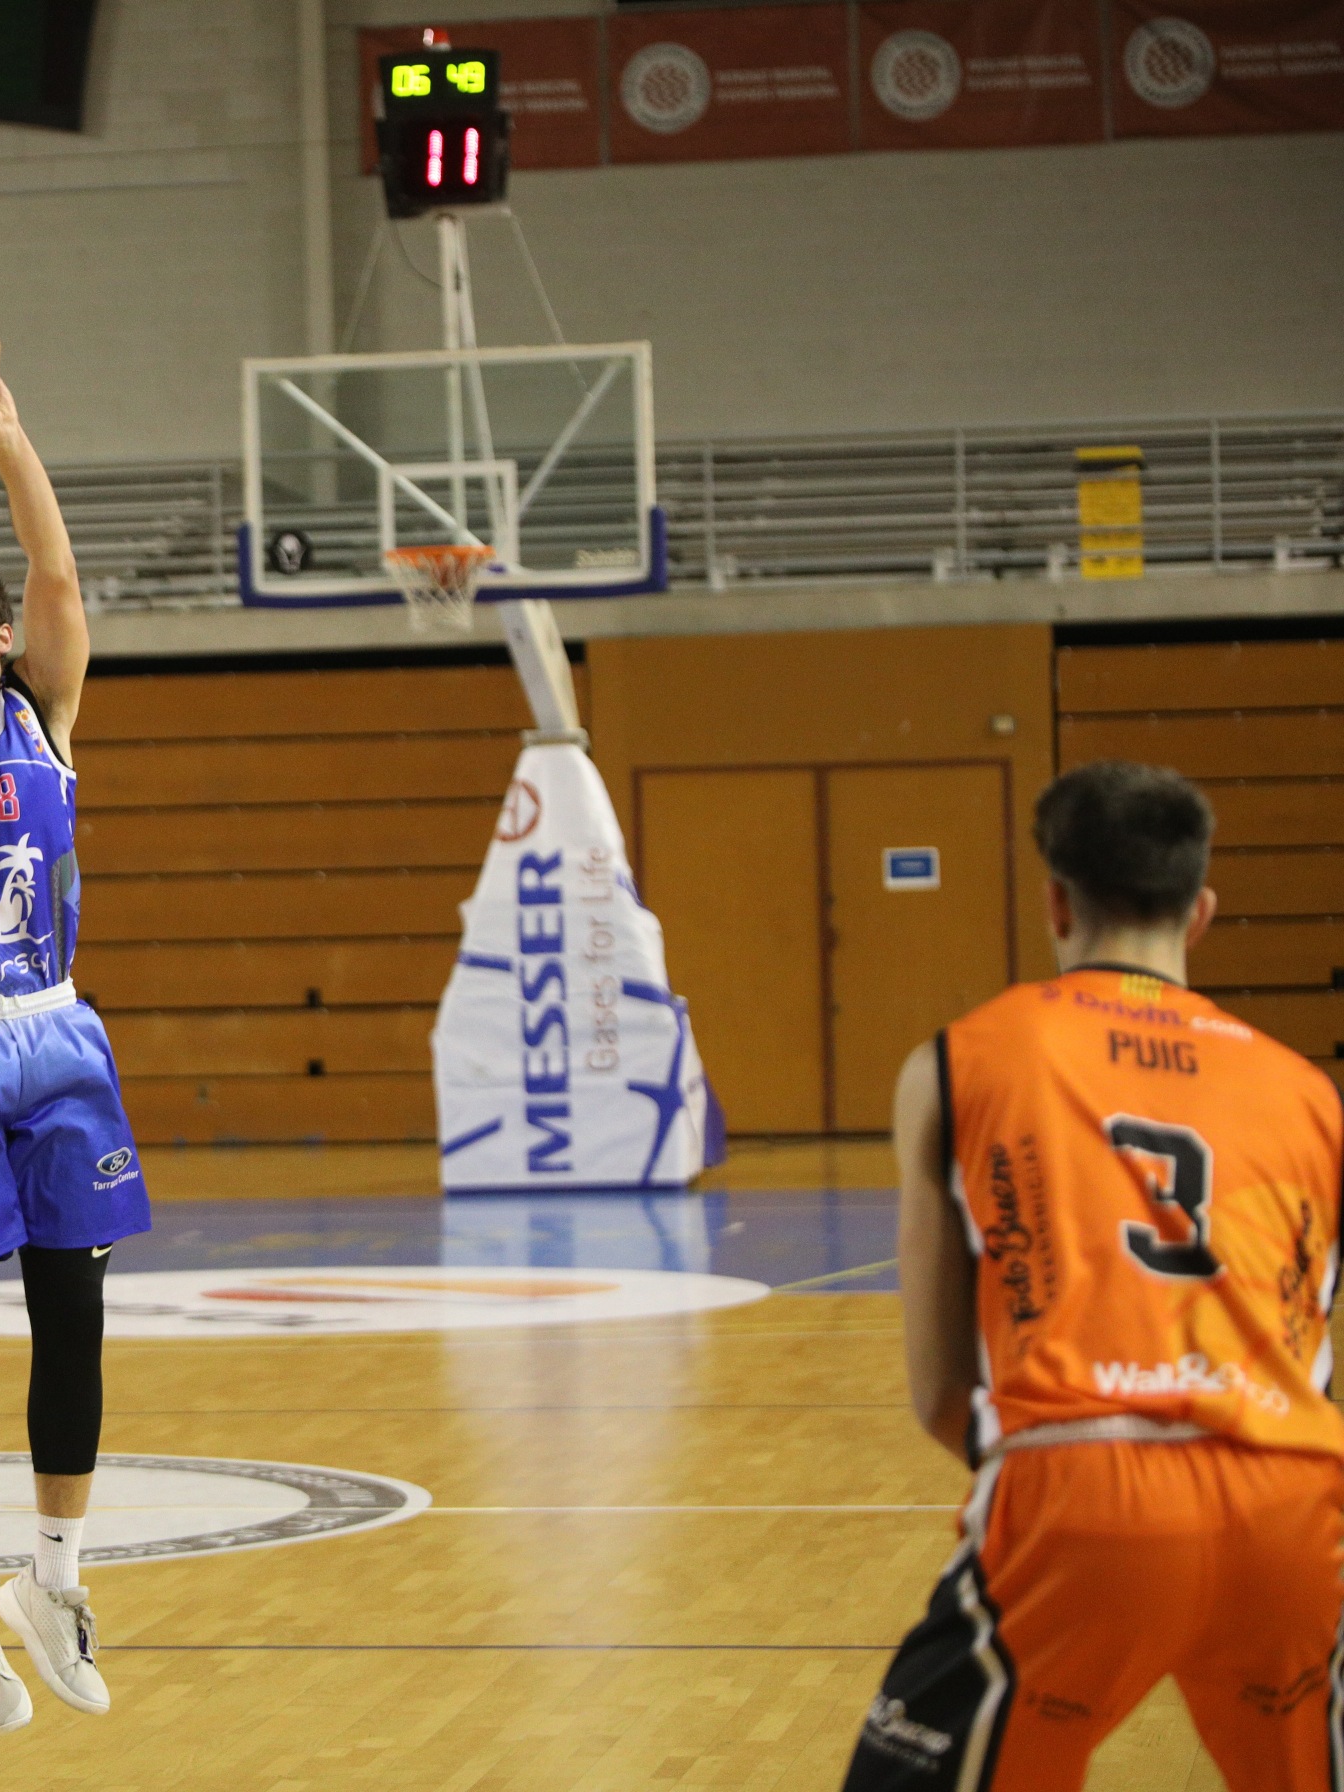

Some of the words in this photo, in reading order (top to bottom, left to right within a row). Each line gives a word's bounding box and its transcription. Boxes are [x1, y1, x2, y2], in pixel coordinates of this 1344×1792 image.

[446, 61, 486, 93] 49
[427, 128, 478, 186] 11
[578, 846, 615, 906] Life
[584, 914, 615, 966] for
[516, 848, 574, 1174] MESSER
[585, 974, 621, 1074] Gases
[1109, 1029, 1199, 1077] PUIG
[1103, 1113, 1223, 1280] 3
